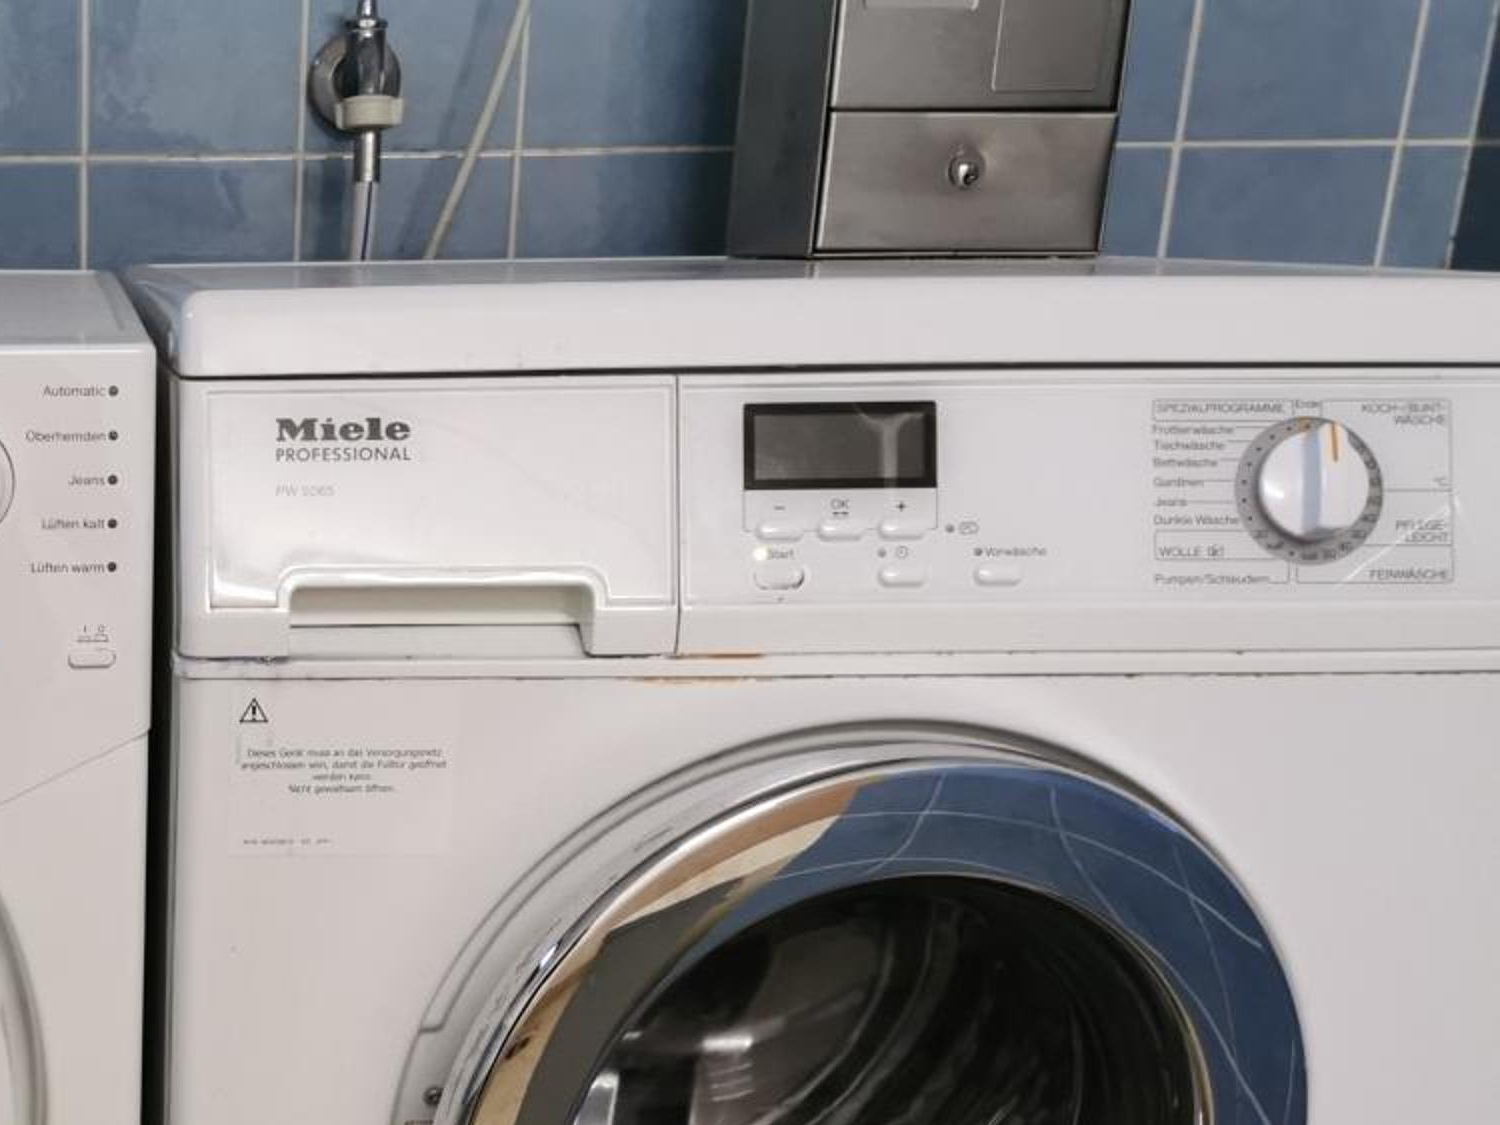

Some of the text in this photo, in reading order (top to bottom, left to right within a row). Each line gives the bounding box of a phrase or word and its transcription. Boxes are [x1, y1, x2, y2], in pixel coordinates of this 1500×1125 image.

[43, 385, 106, 397] Automatic
[275, 417, 411, 442] Miele
[25, 430, 106, 442] Oberhemden
[275, 447, 412, 462] PROFESSIONAL
[68, 475, 105, 486] Jeans
[41, 517, 105, 530] Lüften kalt
[31, 562, 105, 574] Lüften warm
